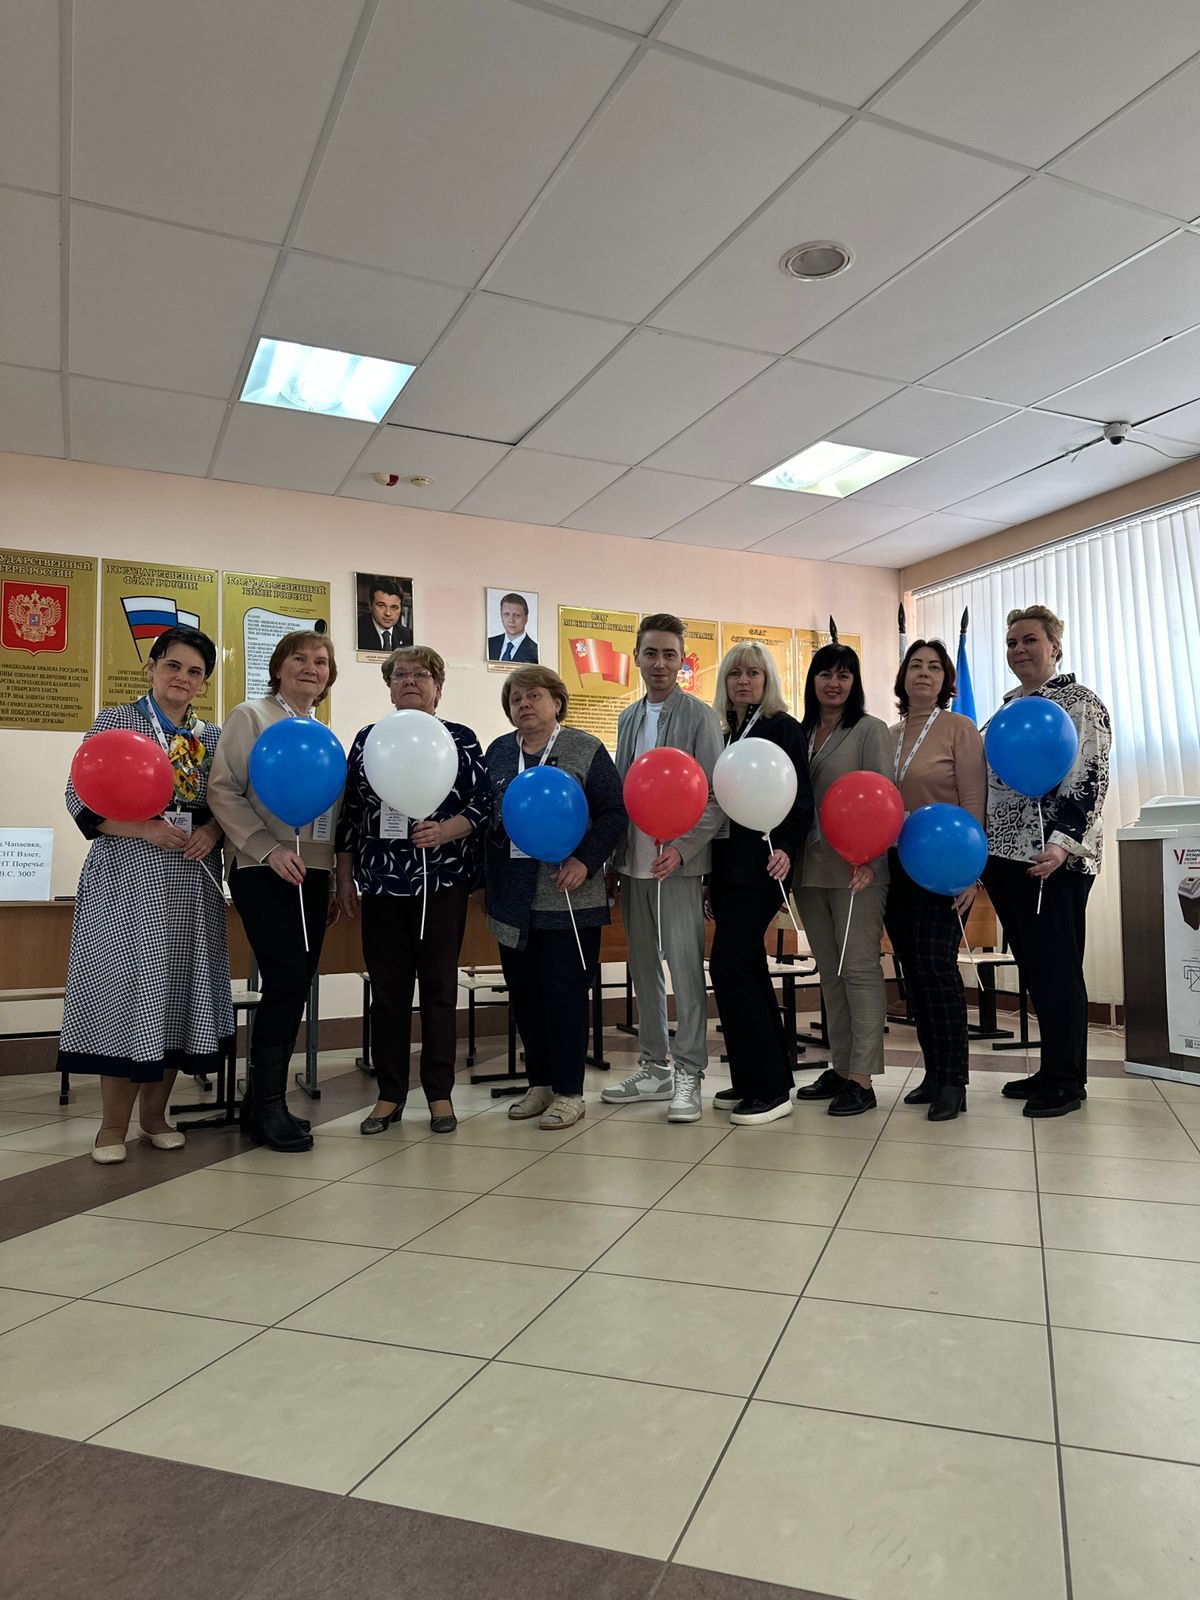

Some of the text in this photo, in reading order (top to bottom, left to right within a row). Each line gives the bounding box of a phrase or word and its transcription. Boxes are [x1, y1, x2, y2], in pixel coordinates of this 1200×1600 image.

[28, 567, 73, 578] РОССИИ
[107, 564, 213, 583] ГОСУДАРСТВЕННЫЙ
[123, 576, 198, 590] ФЛАГ РОССИИ
[227, 576, 326, 595] ГОСУДАРСТВЕННЫЙ
[242, 587, 312, 602] ГИМН РОССИИ
[12, 860, 45, 868] Поречье
[17, 870, 36, 878] 3007
